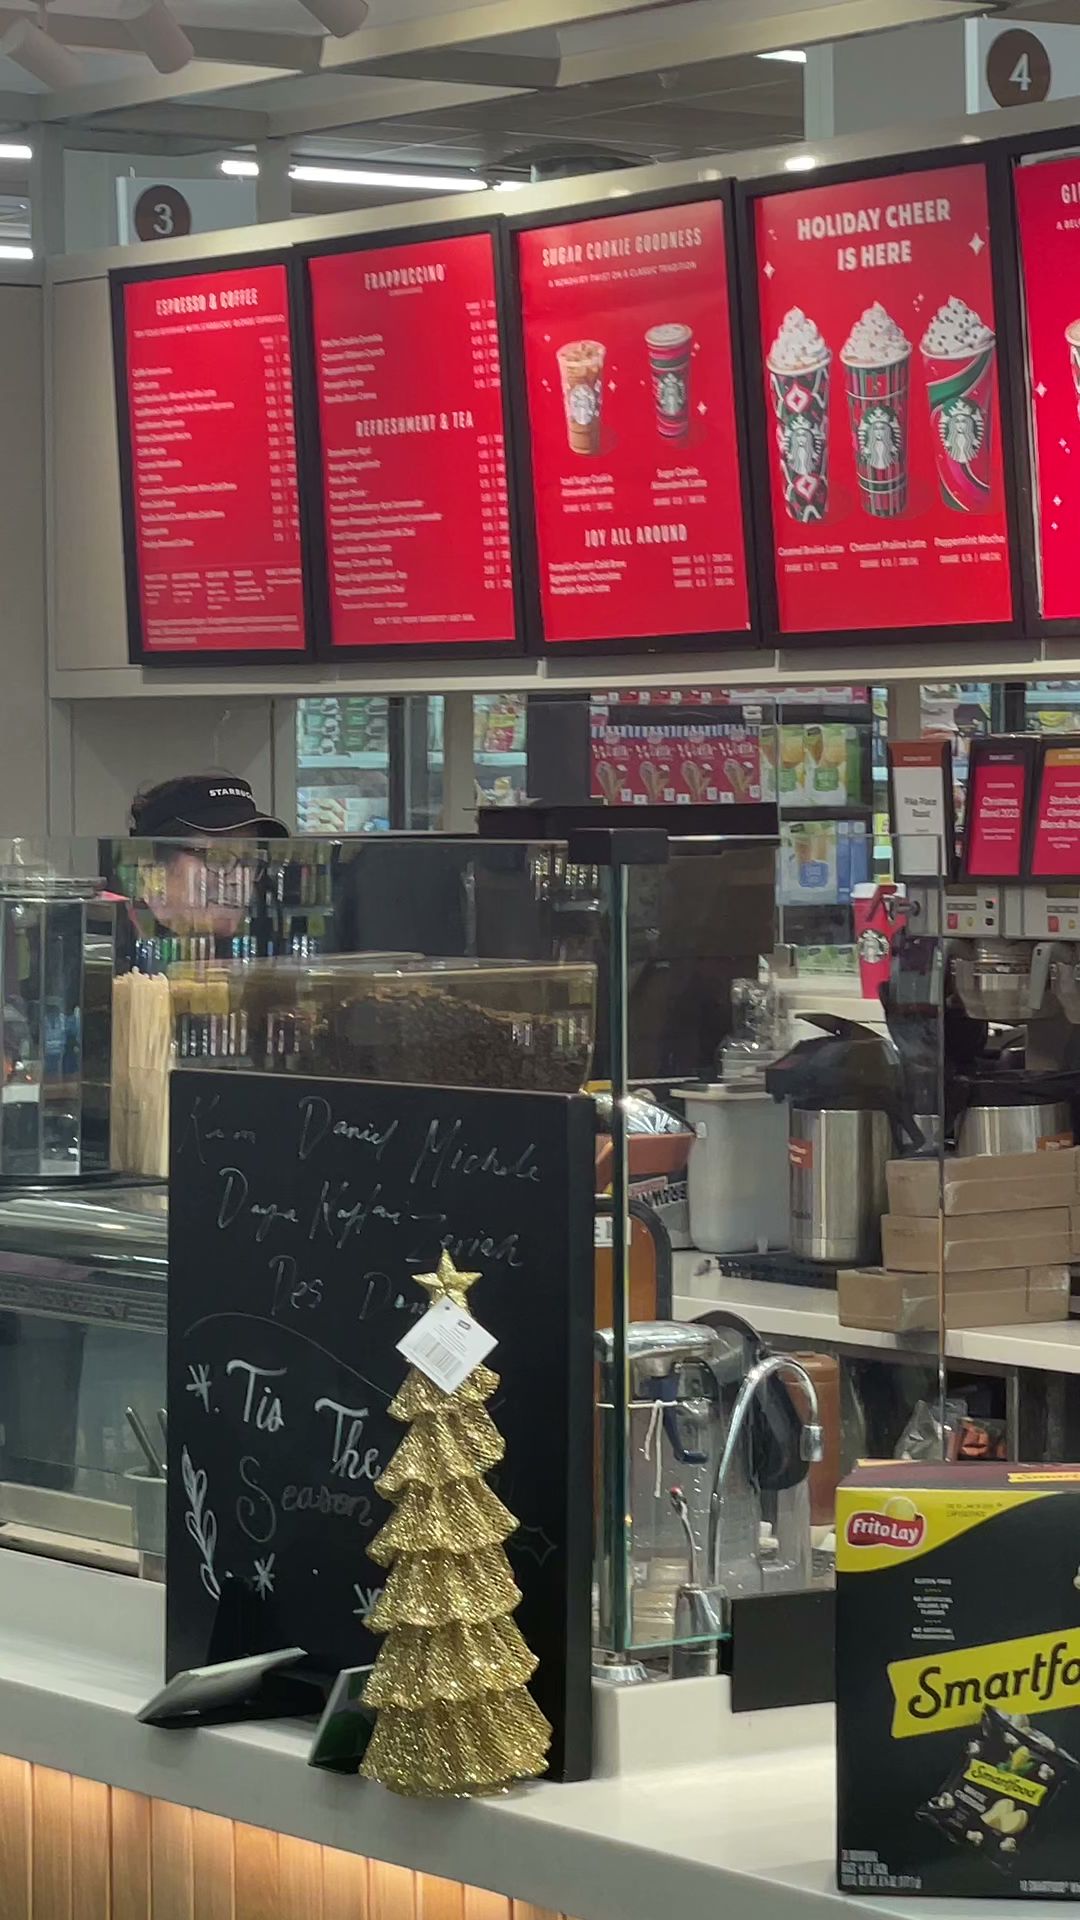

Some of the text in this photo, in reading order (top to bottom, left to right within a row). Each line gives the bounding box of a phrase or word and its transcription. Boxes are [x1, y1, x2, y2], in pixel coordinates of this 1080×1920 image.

[1009, 53, 1032, 91] 4
[153, 203, 174, 235] 3
[797, 198, 950, 241] HOLIDAY CHEER
[542, 227, 702, 268] SUGAR COOKIE GOODNESS
[837, 240, 912, 271] IS HERE
[156, 294, 206, 317] ESPRESSO
[220, 287, 258, 309] COFFEE
[355, 410, 474, 438] REFRESHMENT & TEA
[584, 524, 687, 547] JOY ALL AROUND
[298, 1096, 398, 1160] Daniel
[268, 1254, 323, 1316] Des
[226, 1359, 288, 1433] Tis
[314, 1397, 384, 1481] The
[236, 1456, 374, 1543] Season
[971, 1765, 1038, 1800] Smartfood
